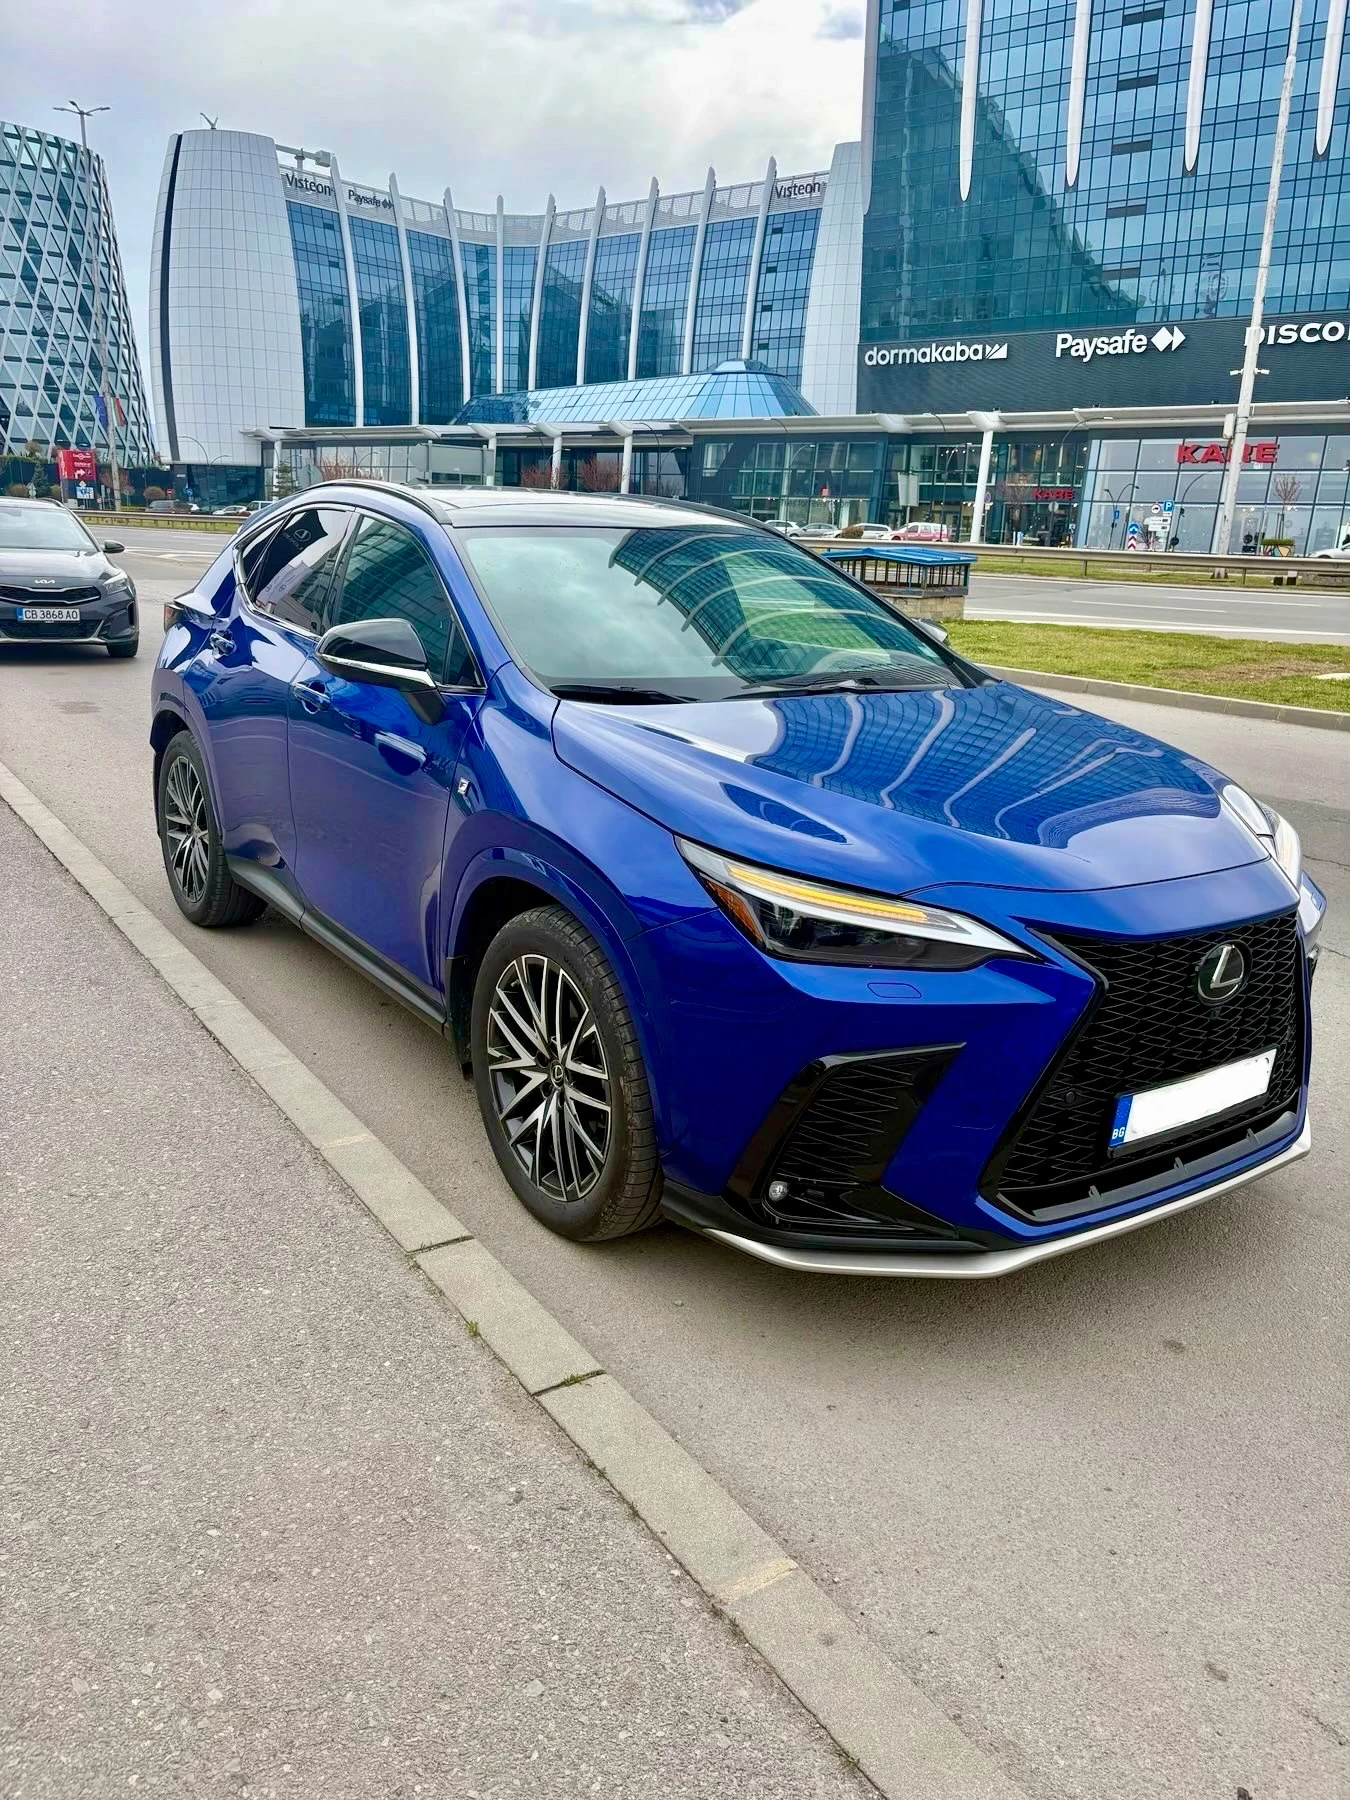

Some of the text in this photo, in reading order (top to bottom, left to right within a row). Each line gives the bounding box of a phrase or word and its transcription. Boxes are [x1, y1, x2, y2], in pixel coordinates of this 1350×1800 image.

[285, 173, 331, 196] Visteon
[775, 182, 820, 199] Visteon
[348, 189, 381, 207] Paysafe
[1244, 321, 1350, 346] DISCO
[864, 341, 984, 366] dormakaba
[1055, 329, 1148, 363] Paysafe
[1032, 488, 1073, 500] KARE
[24, 610, 38, 619] CB
[40, 610, 63, 619] 3868
[1112, 1127, 1126, 1140] BG
